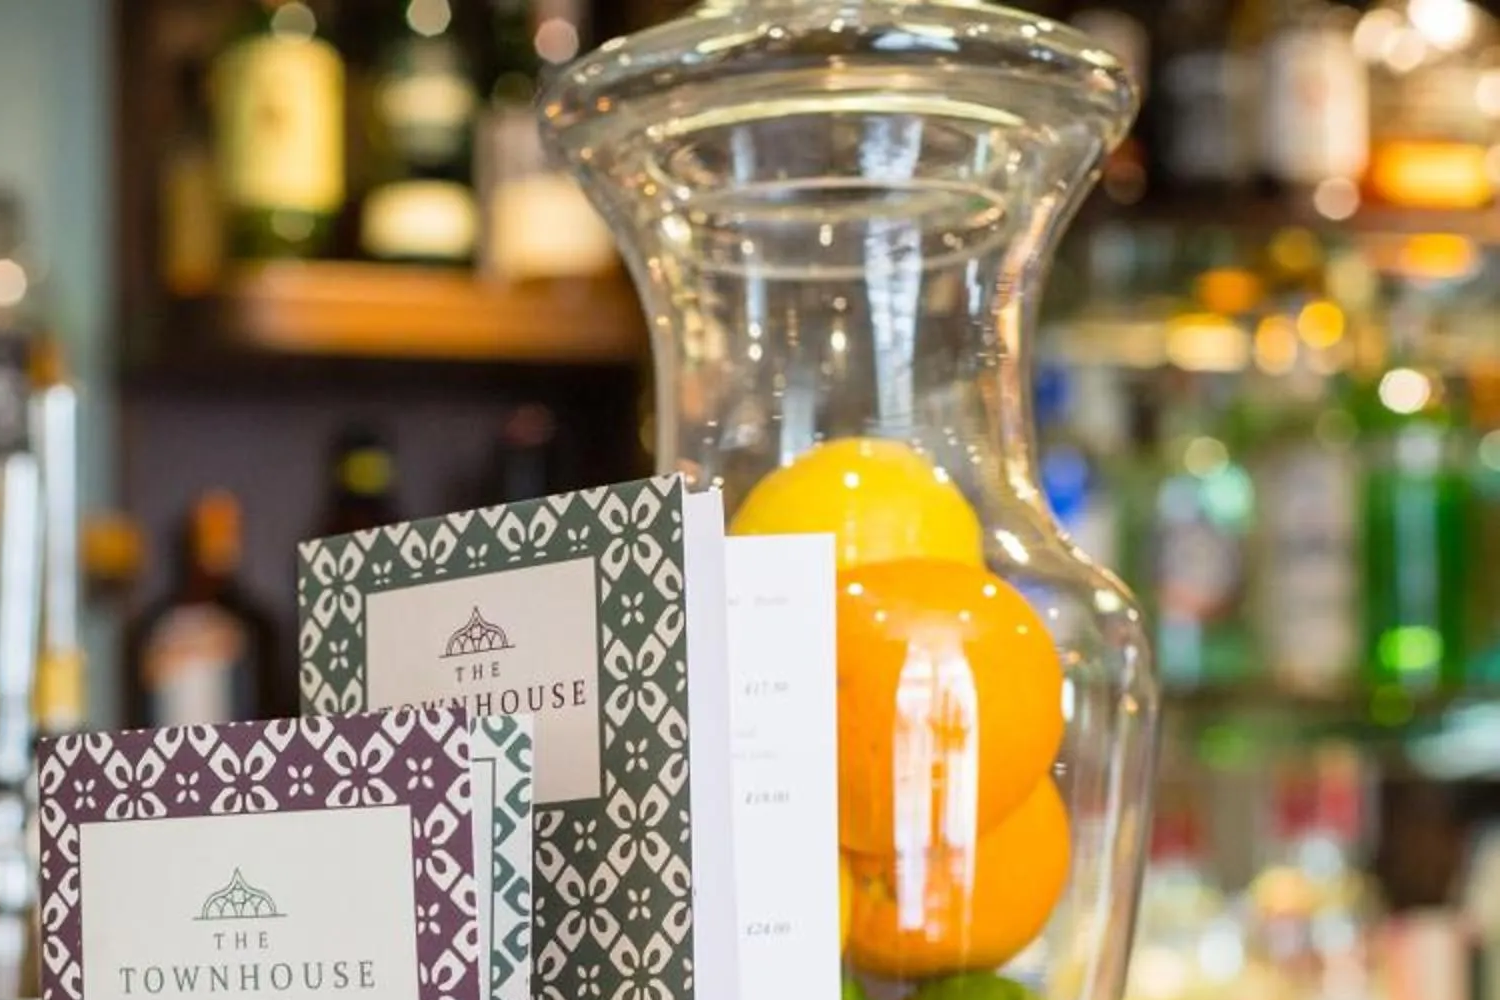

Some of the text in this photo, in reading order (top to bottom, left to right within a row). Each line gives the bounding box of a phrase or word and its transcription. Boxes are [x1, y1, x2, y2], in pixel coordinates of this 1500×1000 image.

[454, 661, 500, 683] THE
[379, 679, 586, 717] HOUSE
[212, 930, 270, 951] THE
[119, 959, 377, 995] TOWNHOUSE
